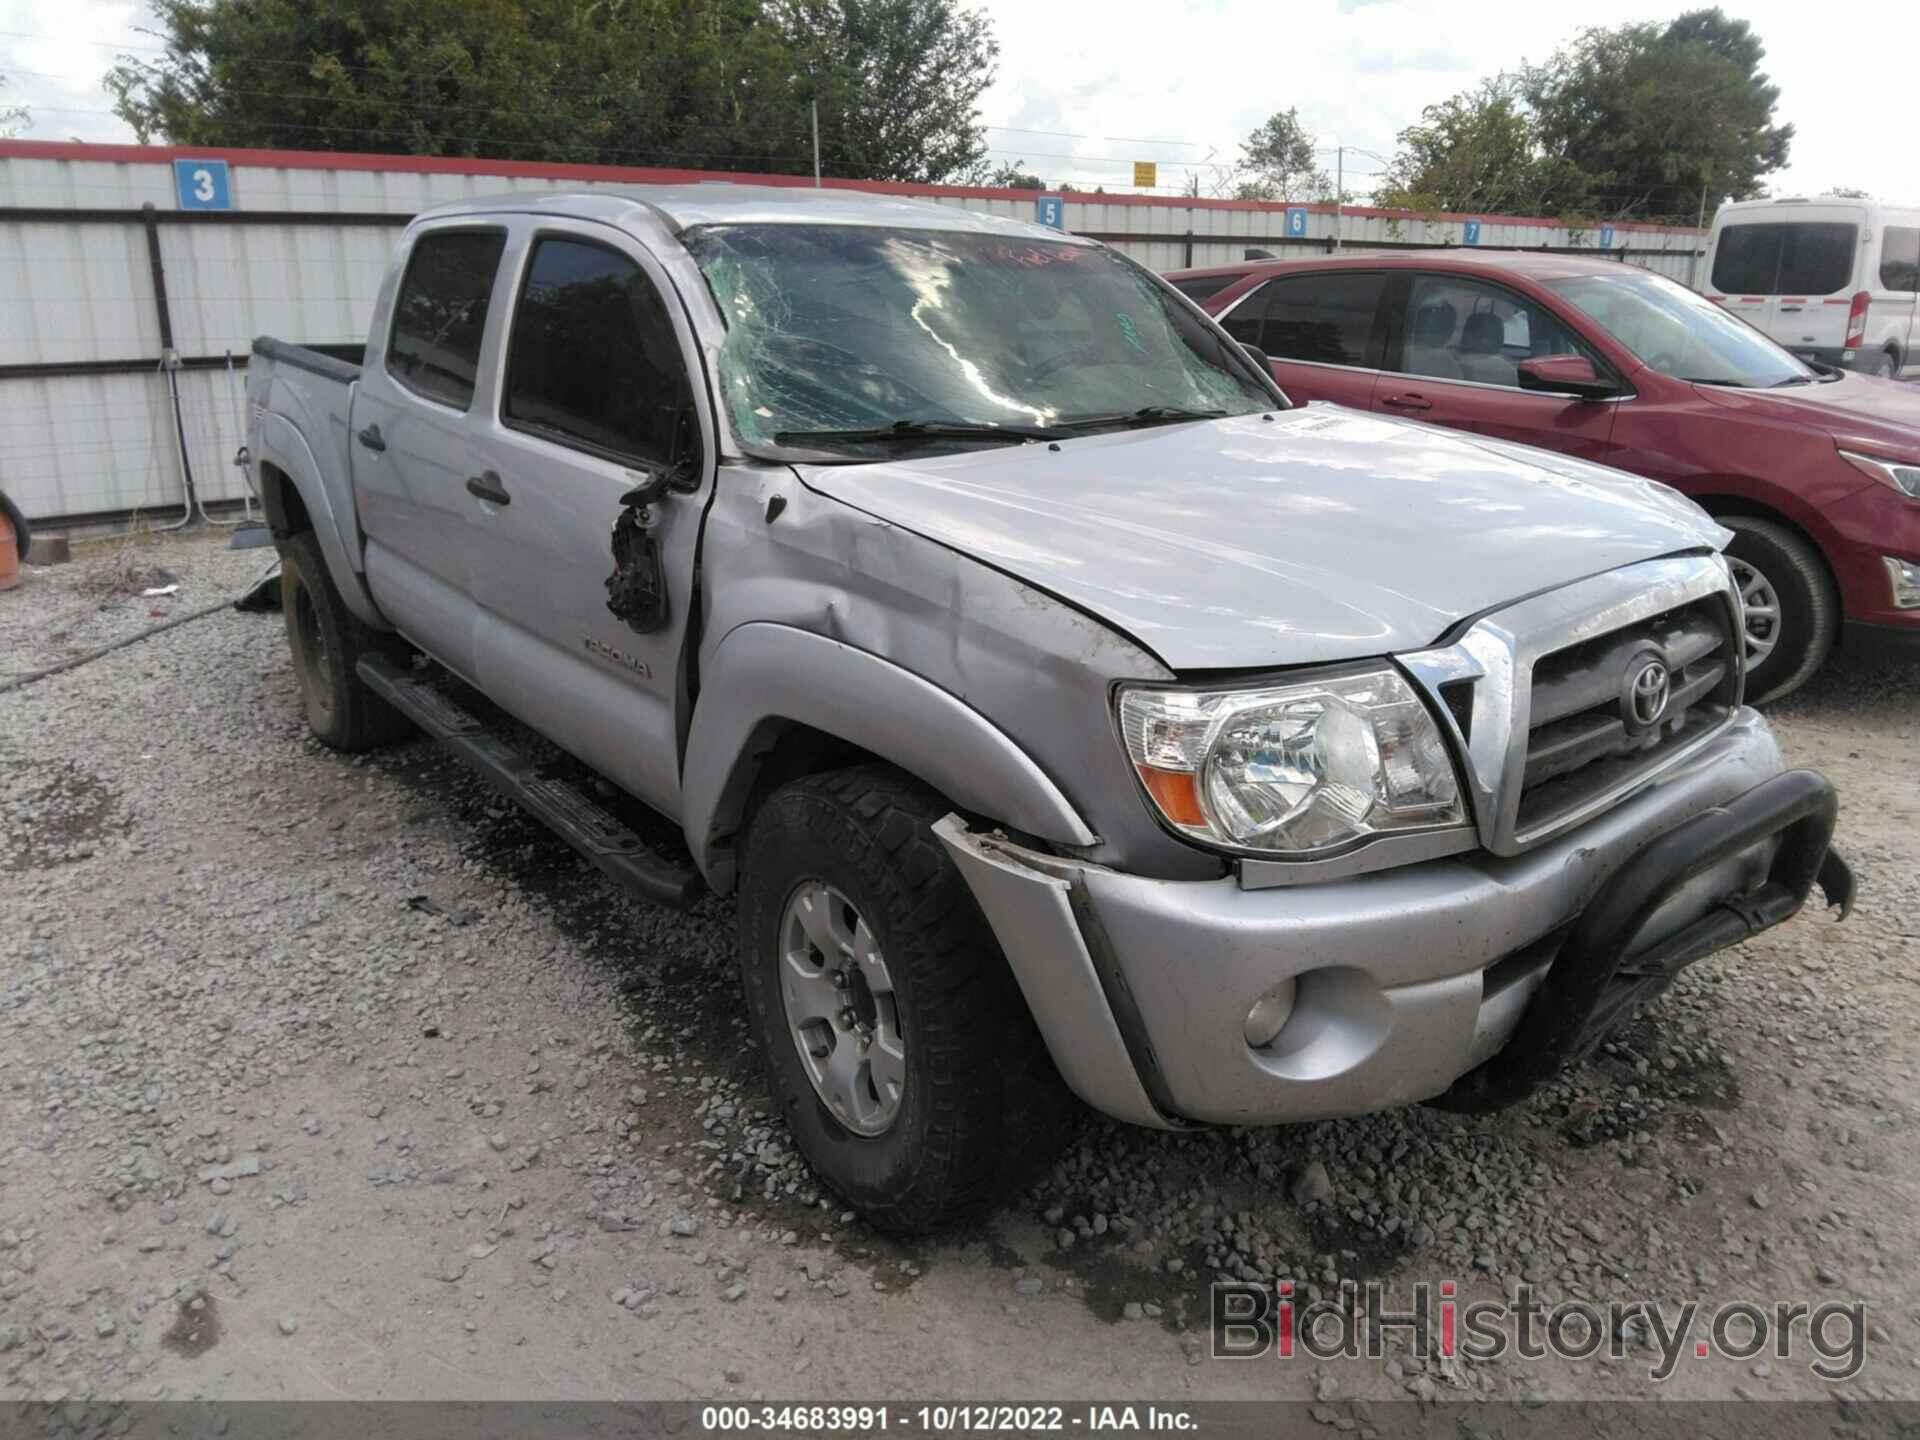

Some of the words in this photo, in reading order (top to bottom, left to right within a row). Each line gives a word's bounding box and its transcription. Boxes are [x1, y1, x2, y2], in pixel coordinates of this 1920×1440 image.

[193, 169, 215, 202] 3
[1046, 203, 1056, 224] 5
[1292, 213, 1301, 230] 6
[1469, 223, 1477, 240] 7
